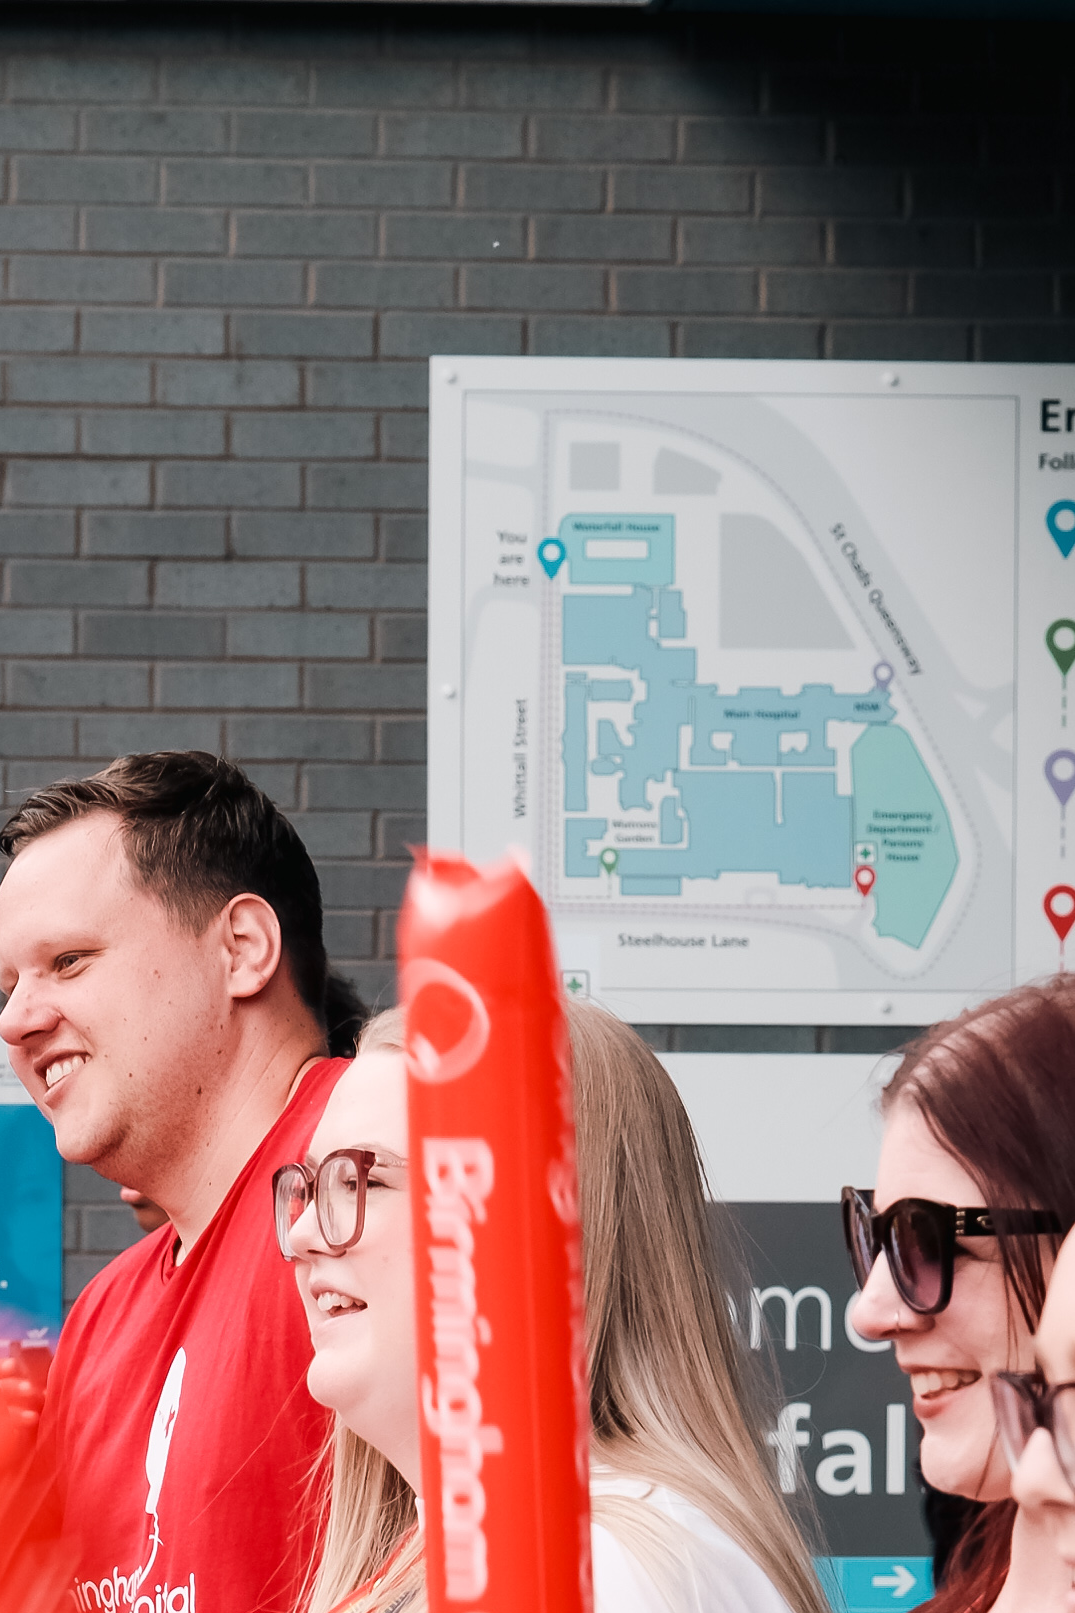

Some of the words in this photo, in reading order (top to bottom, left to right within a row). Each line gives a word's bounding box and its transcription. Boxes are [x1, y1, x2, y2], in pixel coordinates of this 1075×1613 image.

[497, 531, 528, 545] You
[499, 553, 524, 565] are
[492, 573, 530, 587] here
[868, 588, 923, 676] Queensway
[513, 699, 528, 747] Street
[514, 753, 527, 819] Whittall
[618, 932, 706, 948] Steelhouse
[711, 932, 750, 948] Lane
[422, 1136, 504, 1600] Birmingham
